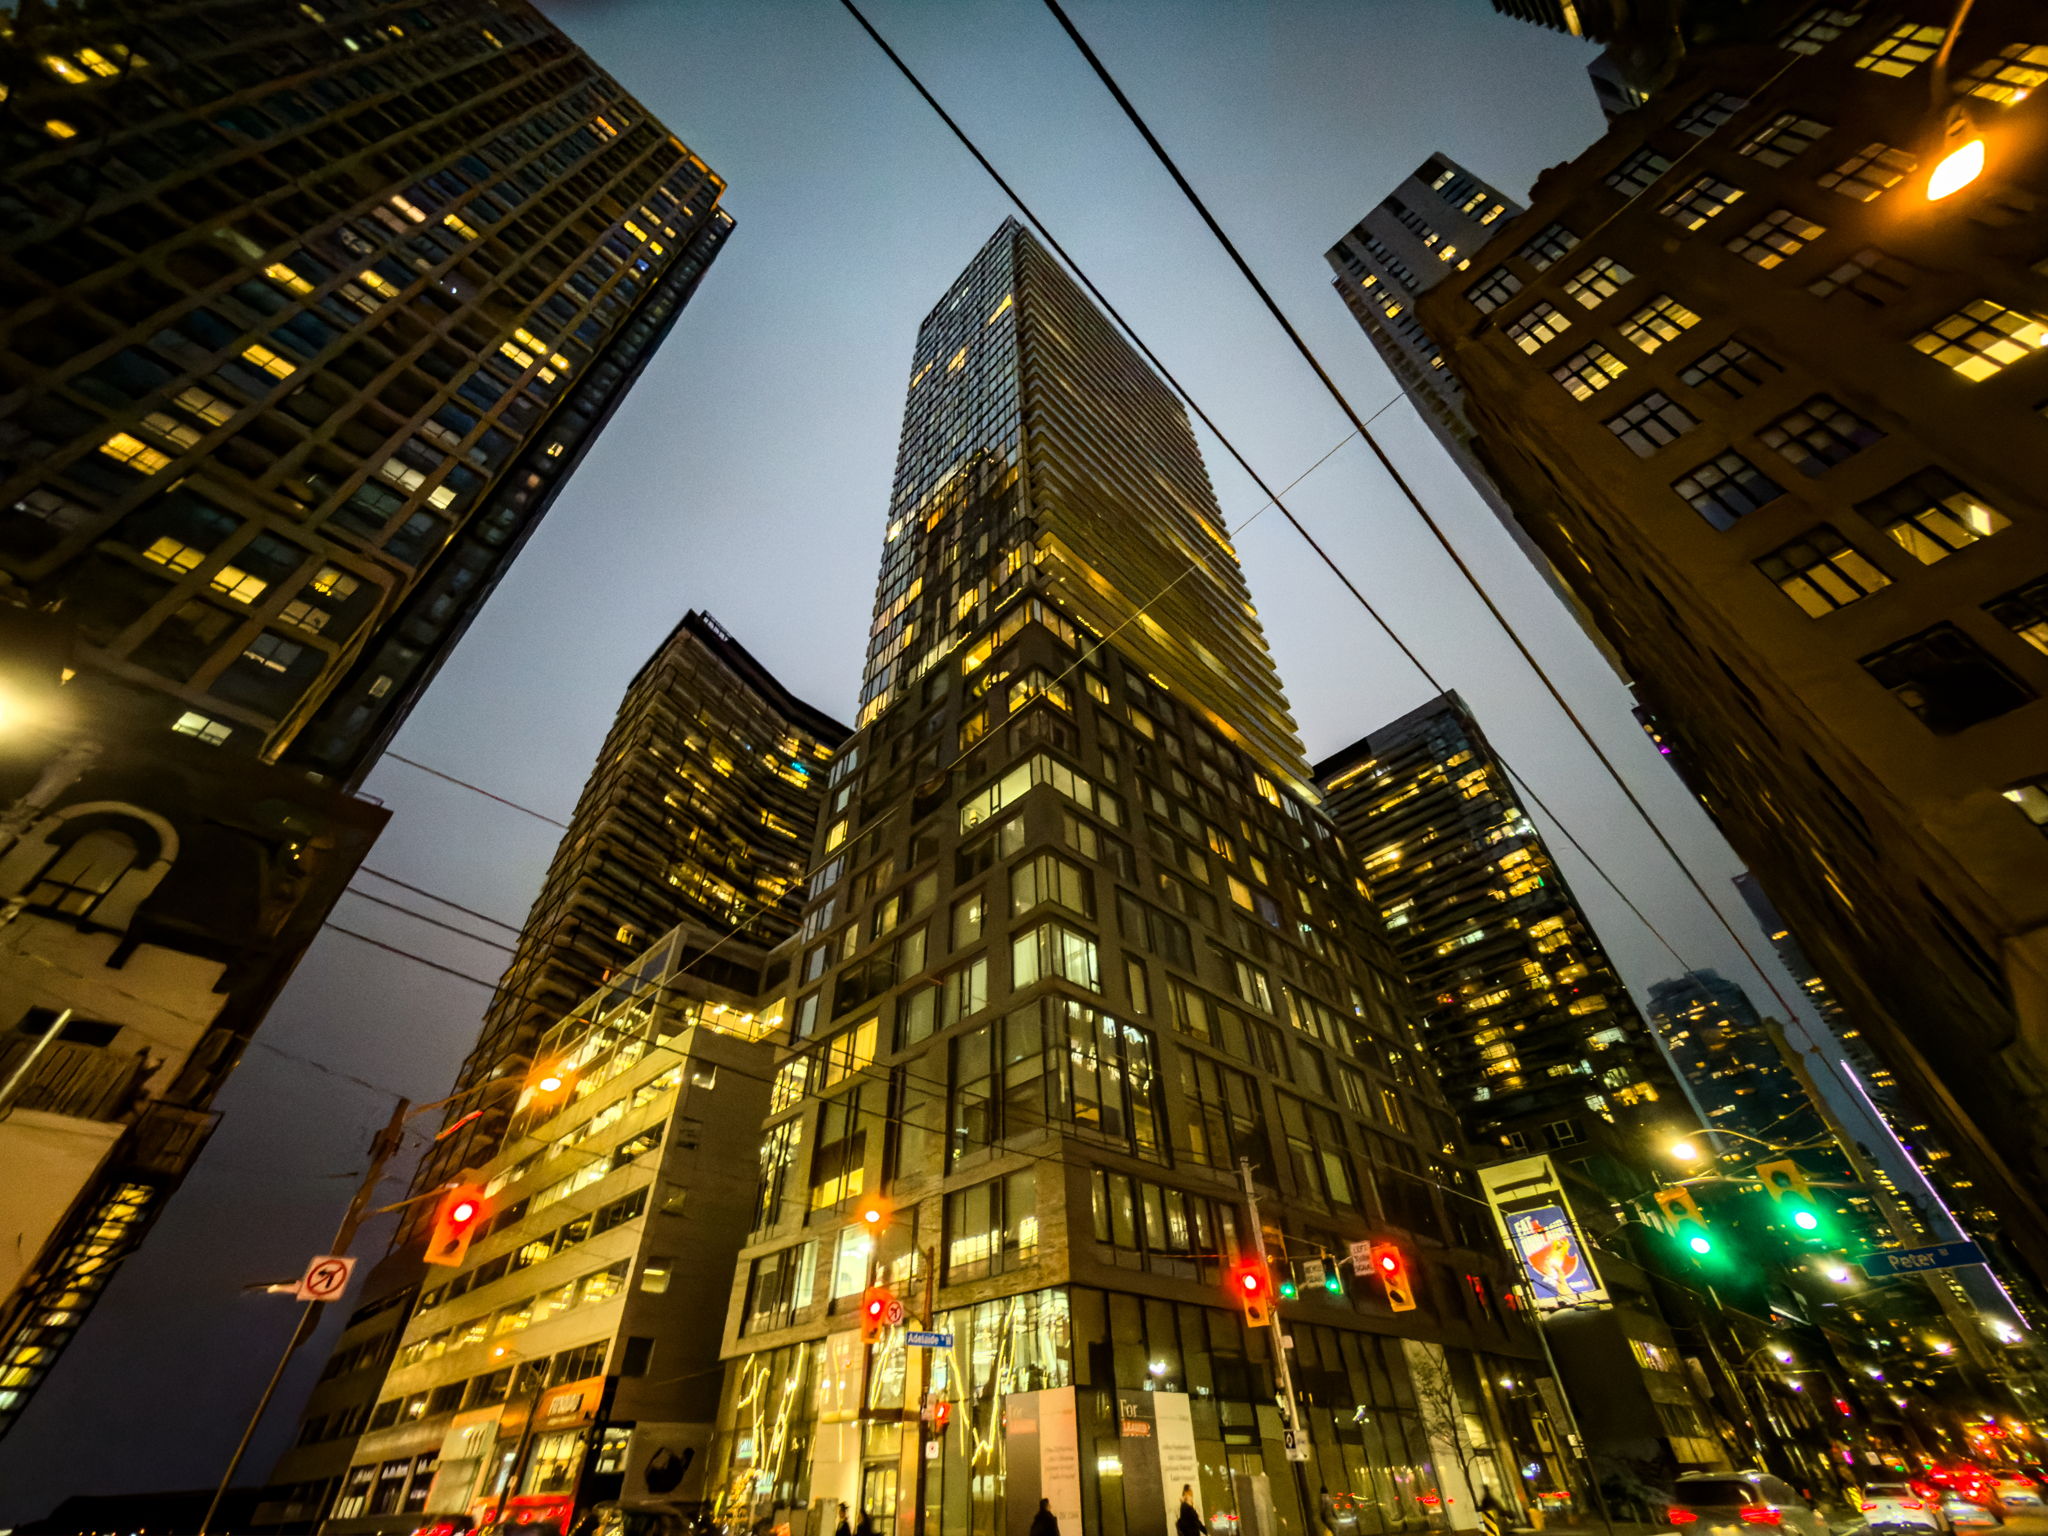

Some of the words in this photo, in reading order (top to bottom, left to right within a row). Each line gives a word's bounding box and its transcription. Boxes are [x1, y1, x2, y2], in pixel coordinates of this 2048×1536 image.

[1887, 1253, 1936, 1270] Peter
[907, 1333, 939, 1345] Adelaide
[1120, 1398, 1138, 1418] For
